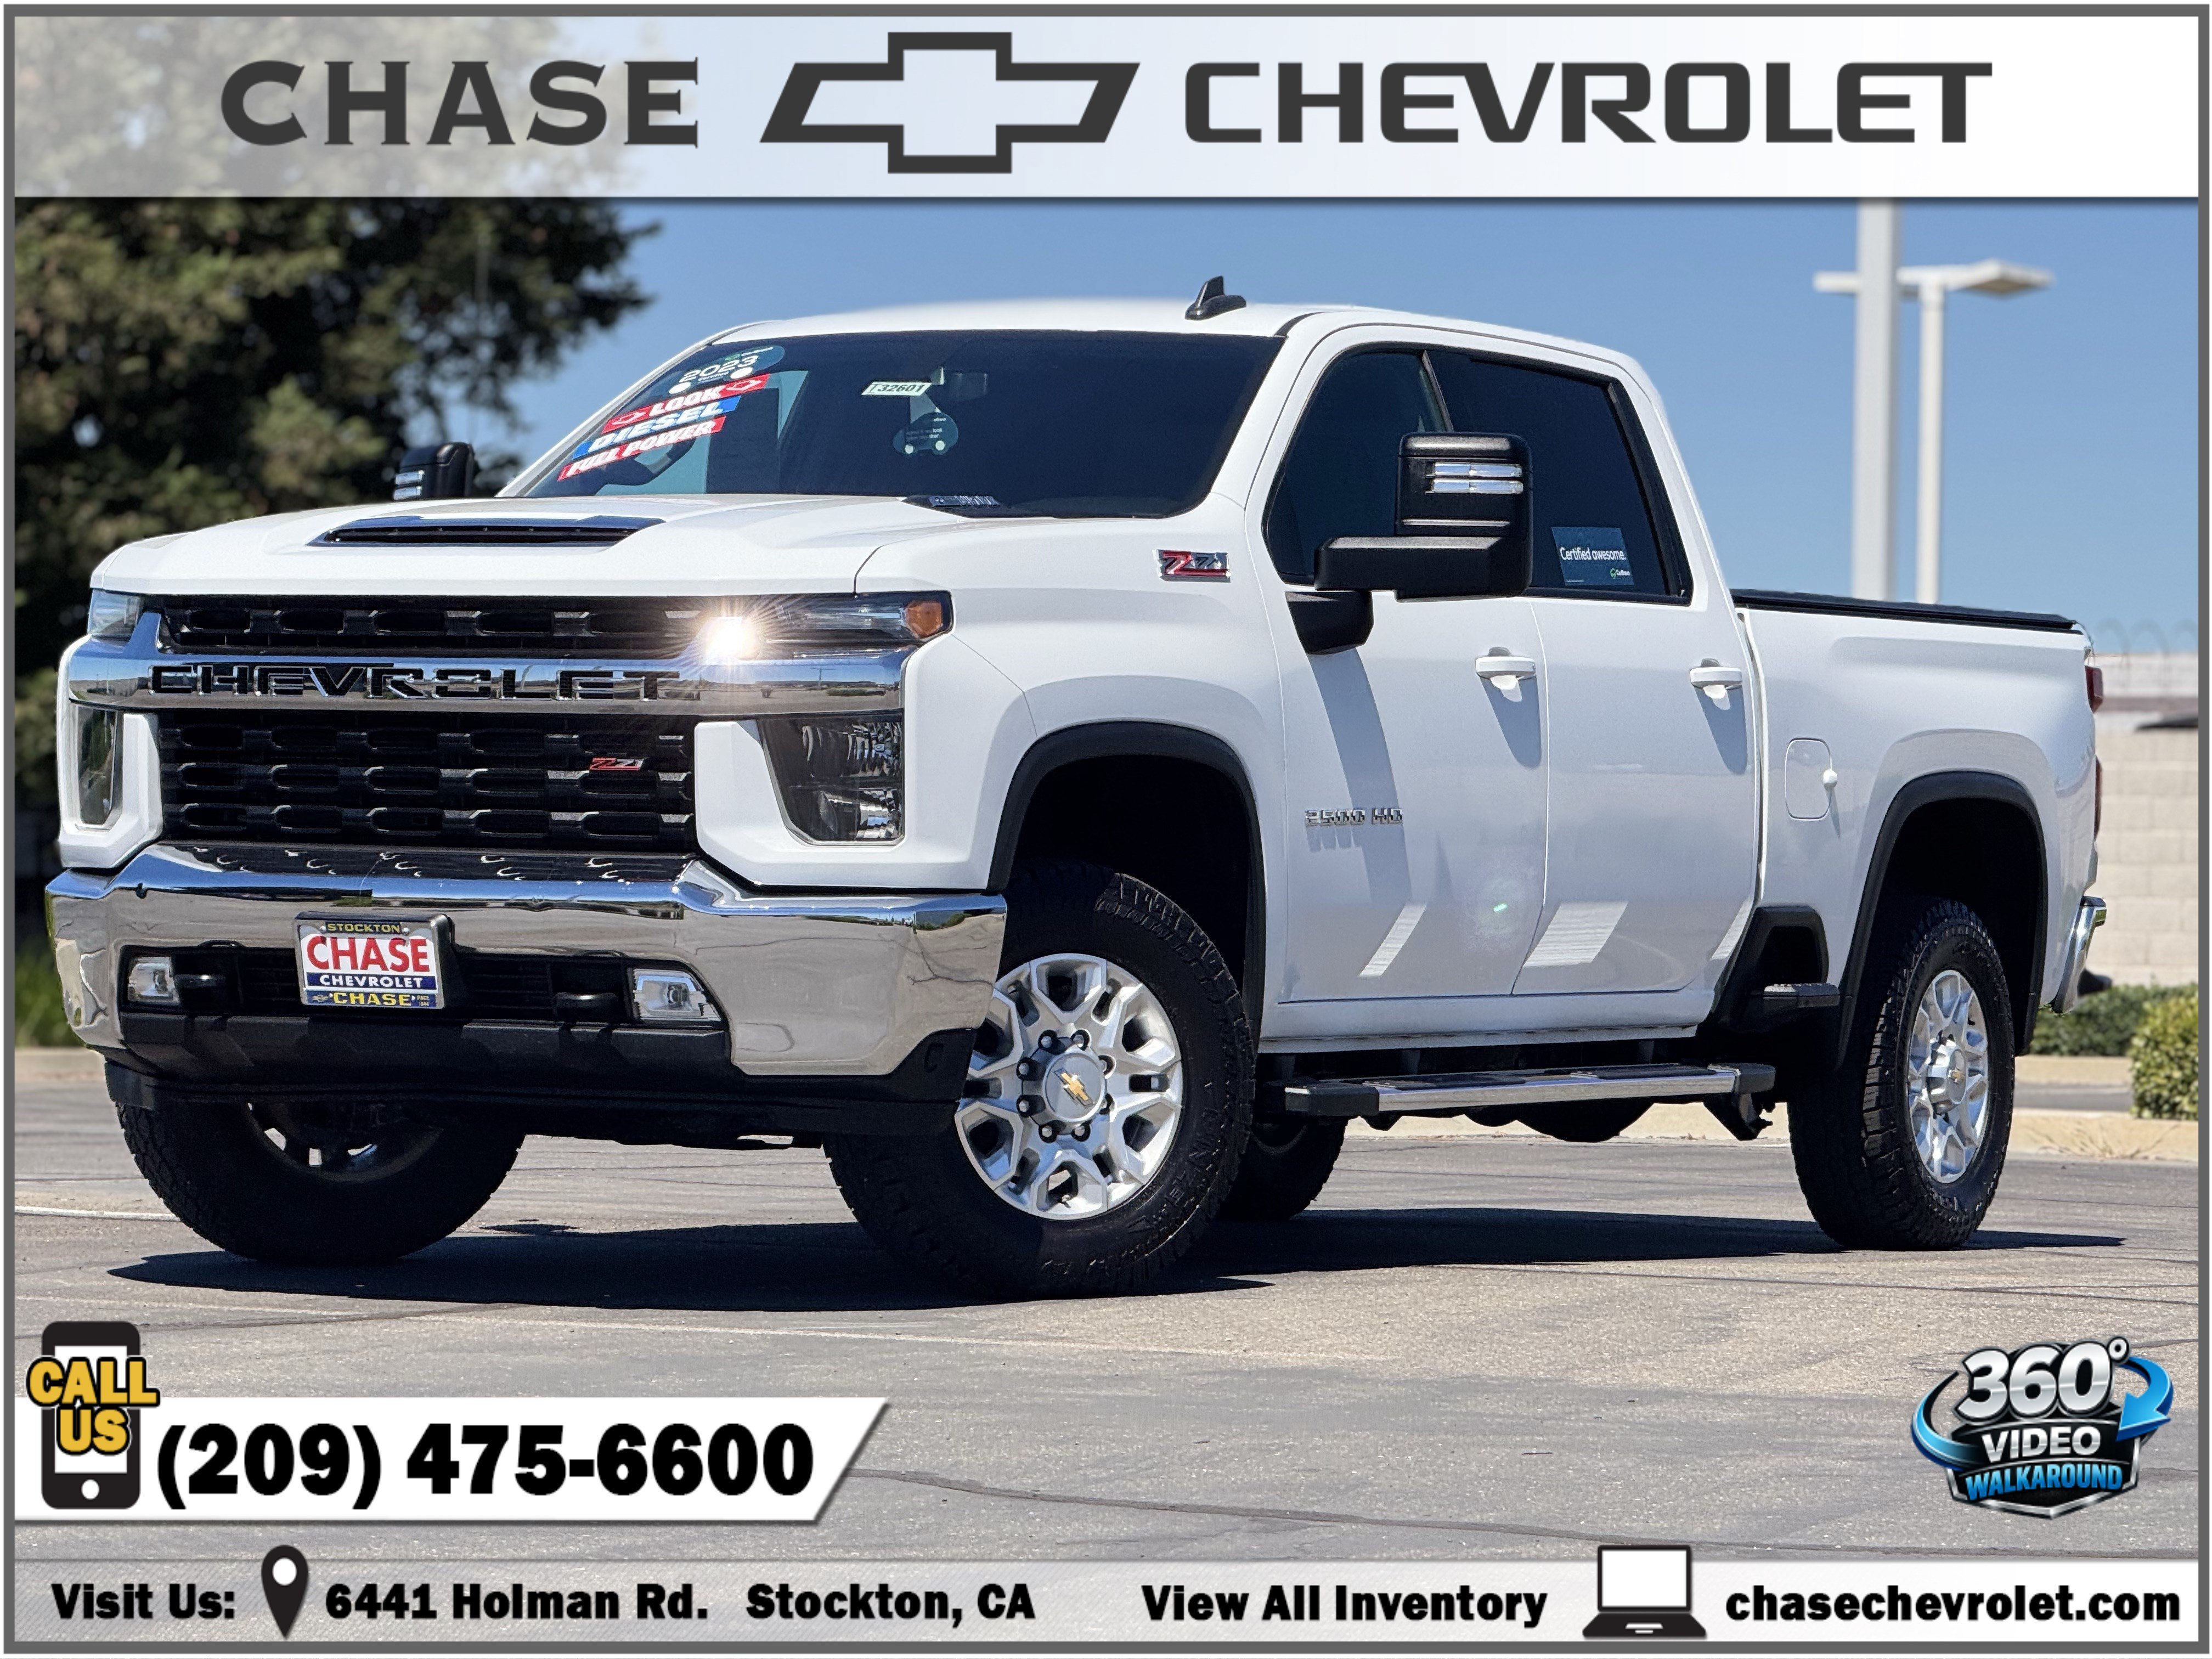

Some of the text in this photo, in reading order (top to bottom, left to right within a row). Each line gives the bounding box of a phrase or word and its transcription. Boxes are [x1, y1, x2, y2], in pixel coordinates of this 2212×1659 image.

[679, 355, 759, 382] 2023
[648, 385, 726, 417] LOOK
[588, 401, 724, 453] DIESEL
[566, 420, 716, 477] FULL POWER
[1560, 546, 1627, 561] Certified awesome.
[148, 664, 680, 701] CHEVROLET
[589, 757, 645, 771] Z71
[1305, 807, 1403, 826] 2500 HD
[328, 923, 400, 933] STOCKTON
[307, 935, 430, 972] CHASE
[319, 974, 422, 988] CHEVROLET
[333, 992, 412, 1006] CHASE
